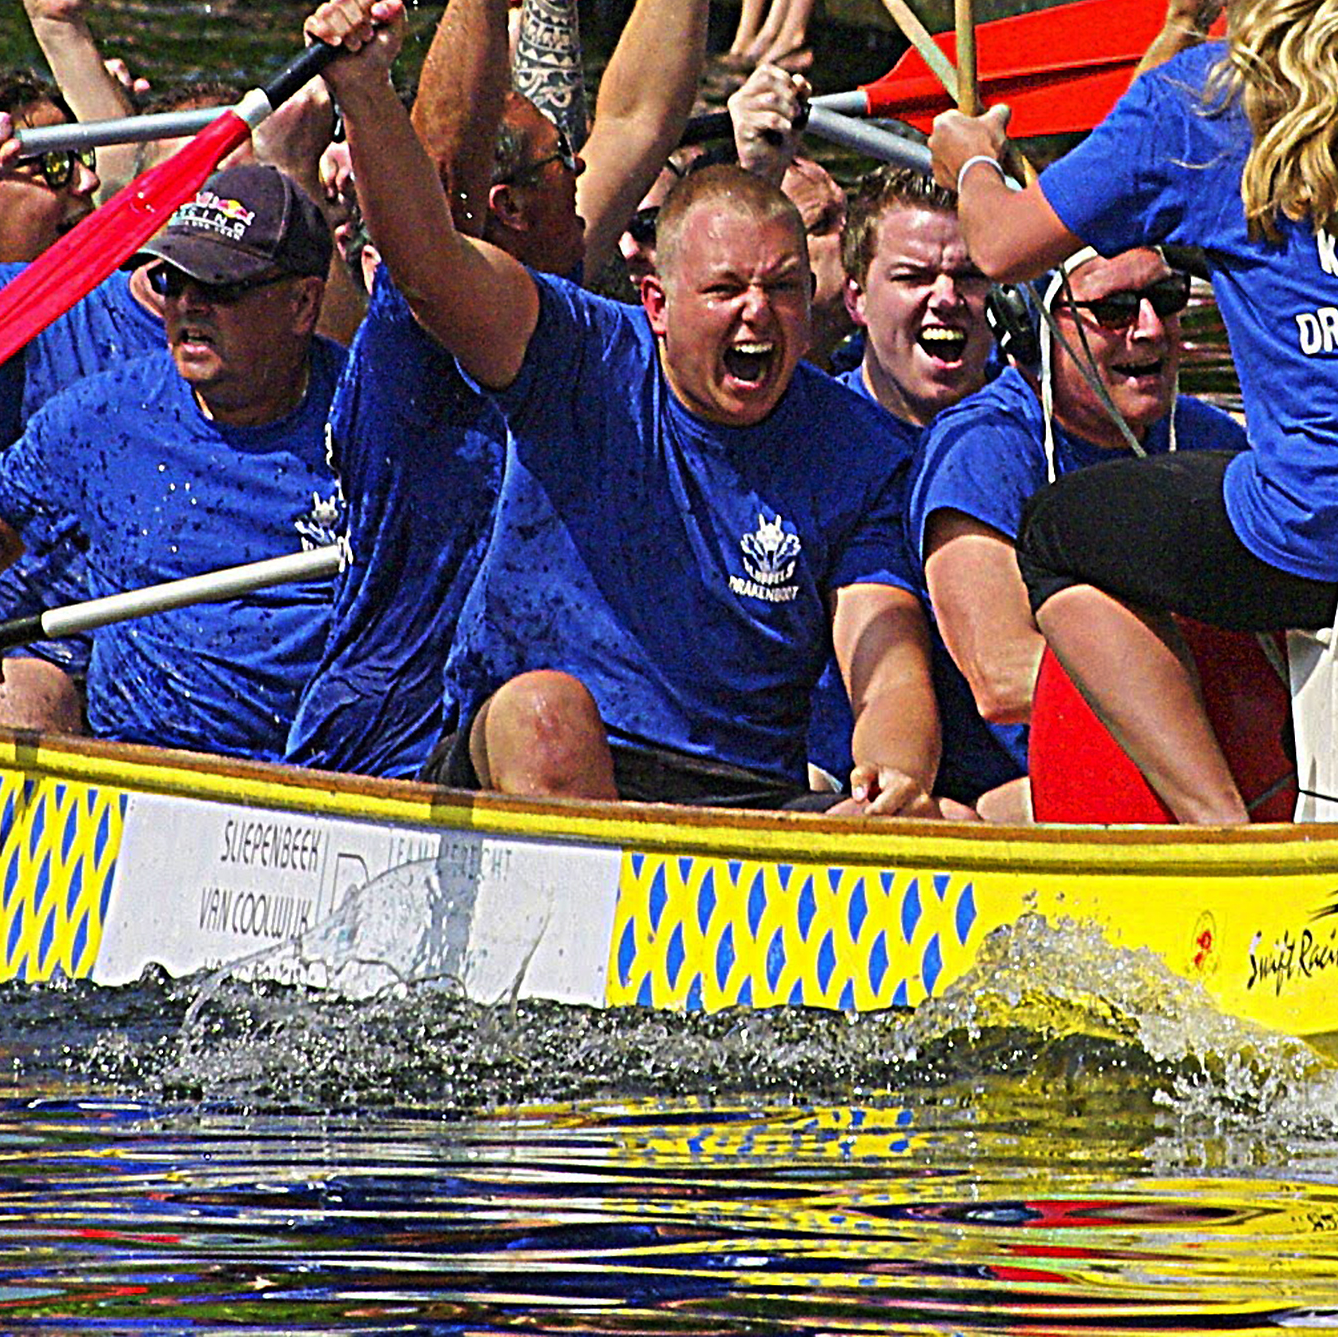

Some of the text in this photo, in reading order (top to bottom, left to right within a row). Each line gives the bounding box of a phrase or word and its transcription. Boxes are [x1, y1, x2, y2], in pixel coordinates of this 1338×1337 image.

[220, 819, 321, 872] SLIEPENBEEK
[199, 886, 312, 942] VAN COOLWIJK
[1246, 929, 1296, 996] Swift
